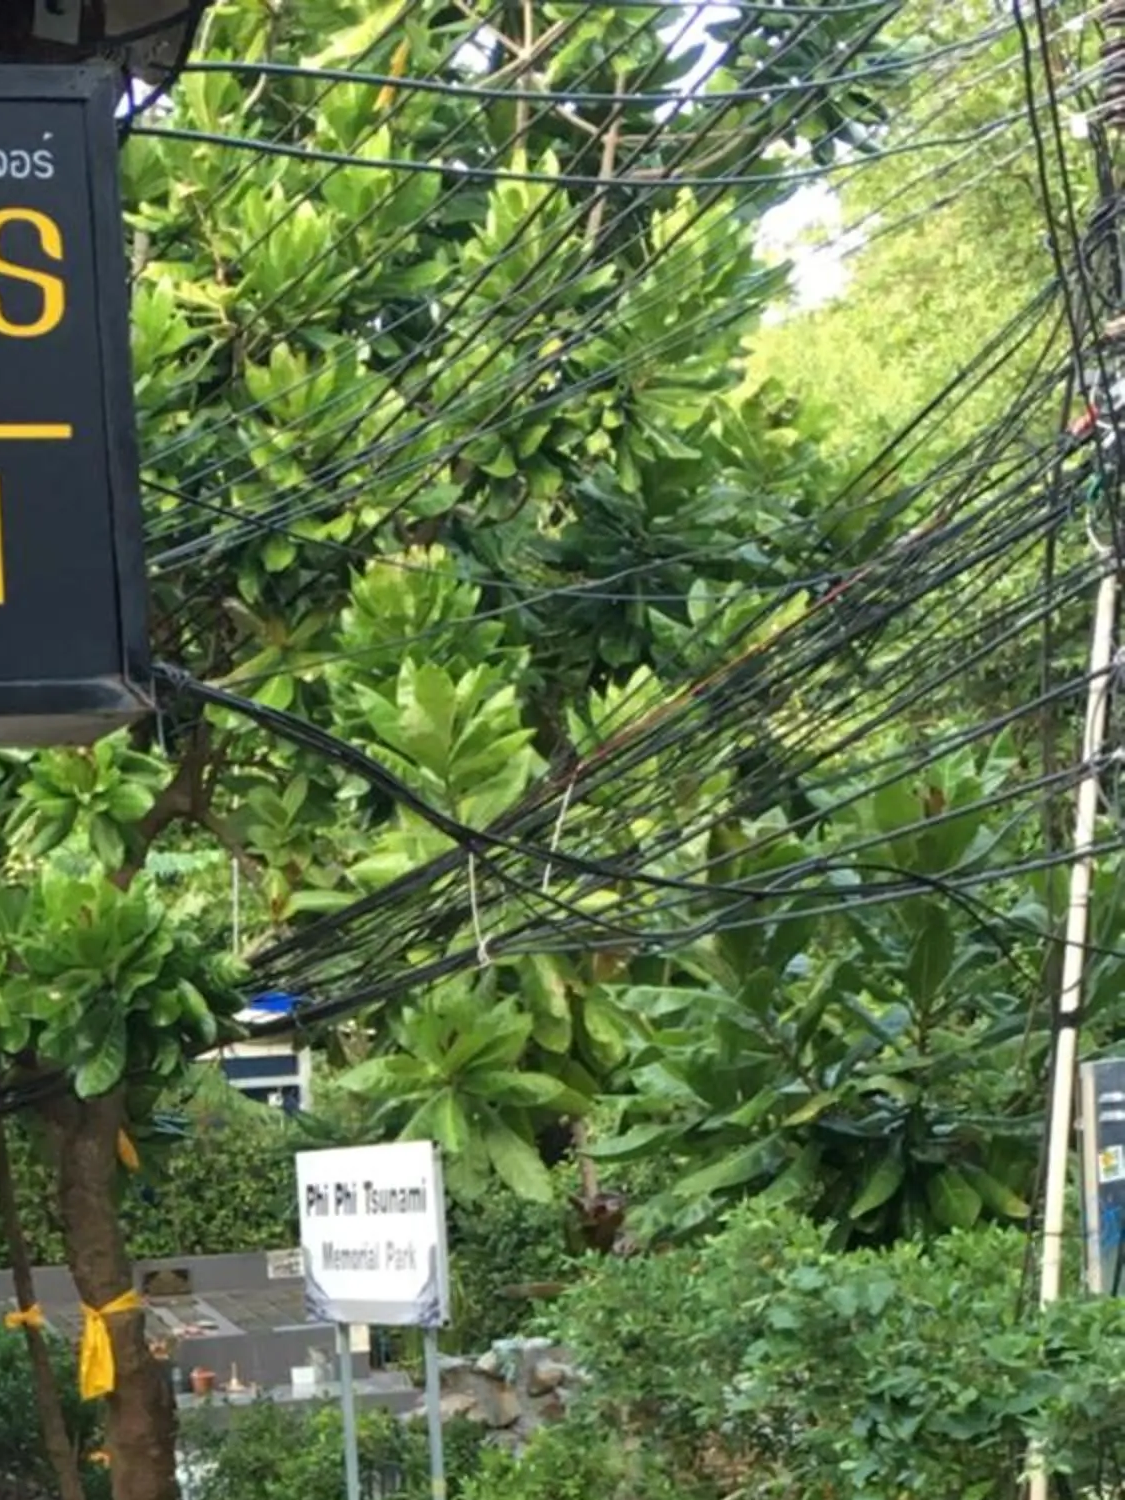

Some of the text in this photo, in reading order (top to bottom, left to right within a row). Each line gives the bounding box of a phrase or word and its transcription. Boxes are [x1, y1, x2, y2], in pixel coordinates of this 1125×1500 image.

[306, 1176, 427, 1217] Phi Phi Tsunami
[322, 1240, 417, 1271] Memorial Park
